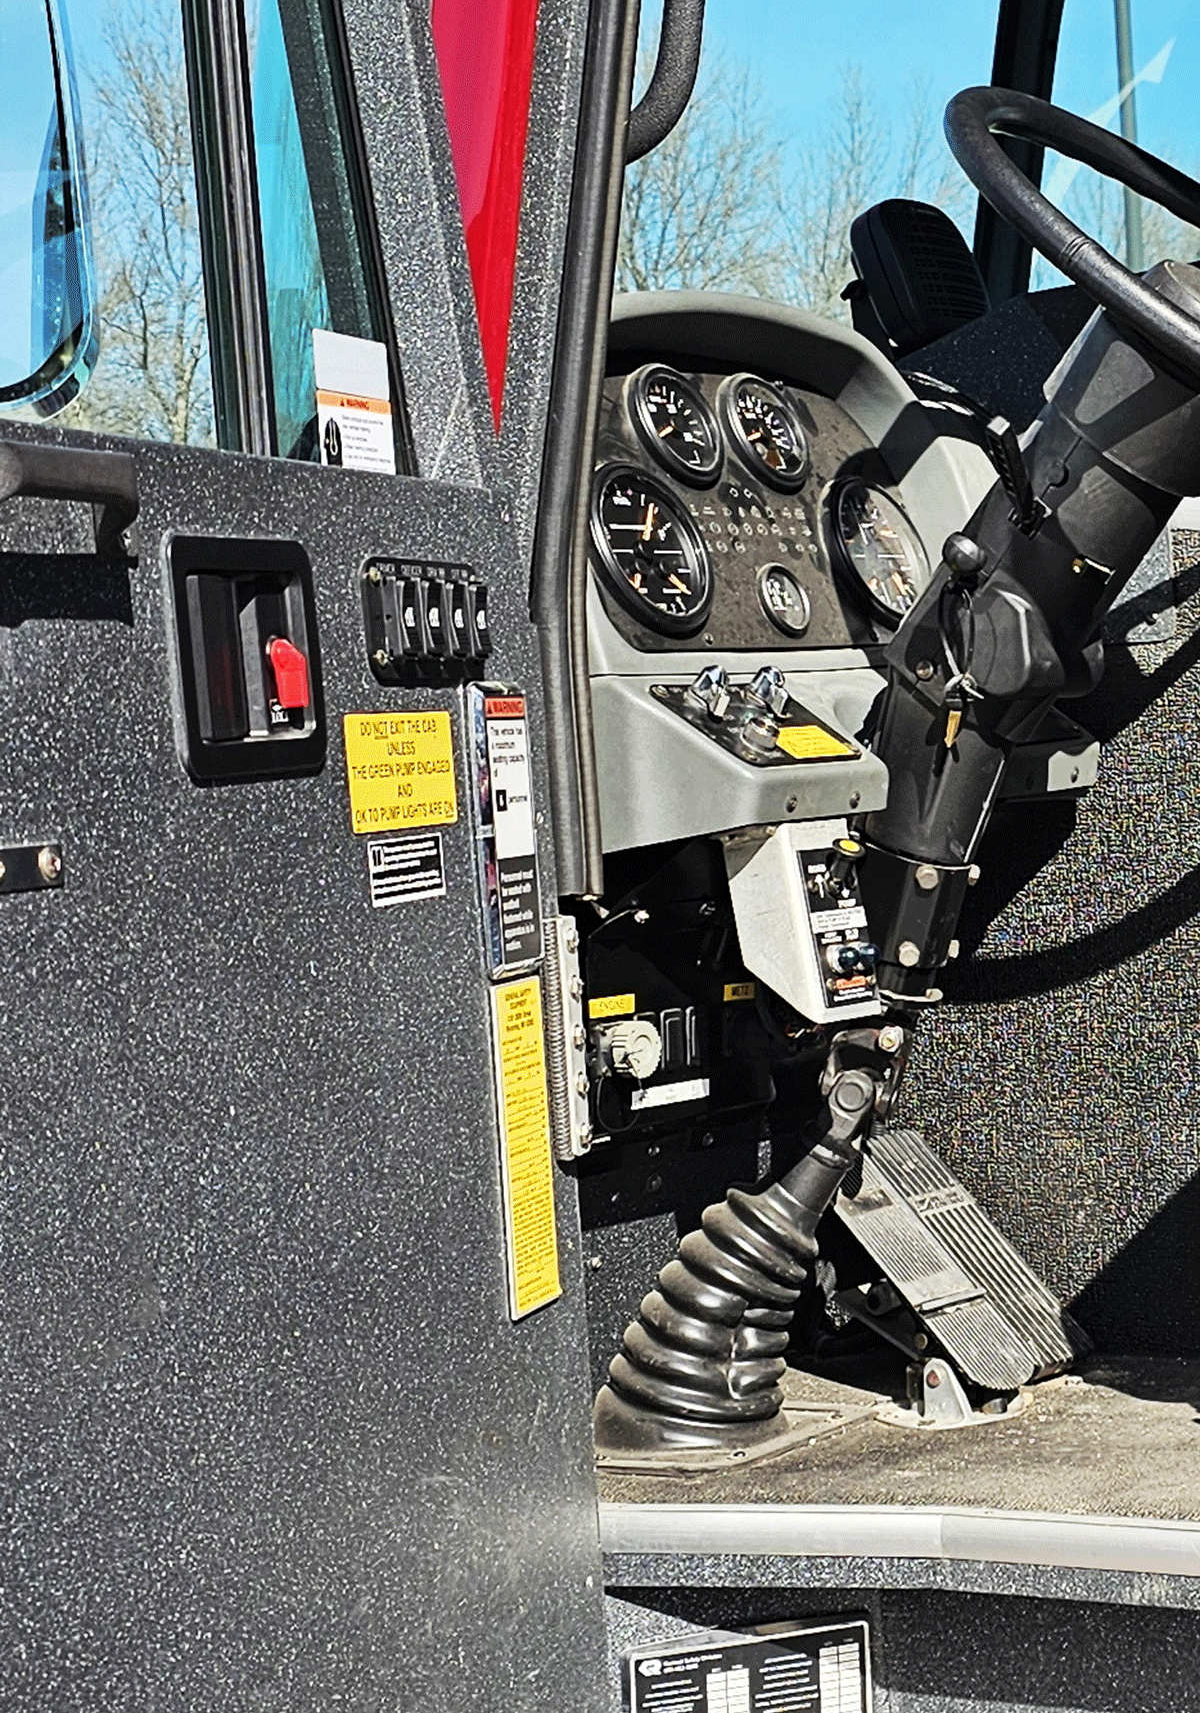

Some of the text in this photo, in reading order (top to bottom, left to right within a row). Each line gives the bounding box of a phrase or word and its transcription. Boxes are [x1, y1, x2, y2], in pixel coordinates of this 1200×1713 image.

[493, 700, 523, 714] WARNING
[361, 719, 437, 736] DO NOT EXIT THE CAB
[387, 740, 416, 756] UNLESS
[351, 759, 451, 780] THE GREEN PUMP ENGAGED
[397, 783, 413, 798] AND
[355, 809, 367, 824] OK
[368, 808, 379, 822] TO
[380, 806, 400, 822] PUMP
[402, 803, 428, 819] LIGHTS
[429, 801, 442, 816] ARE
